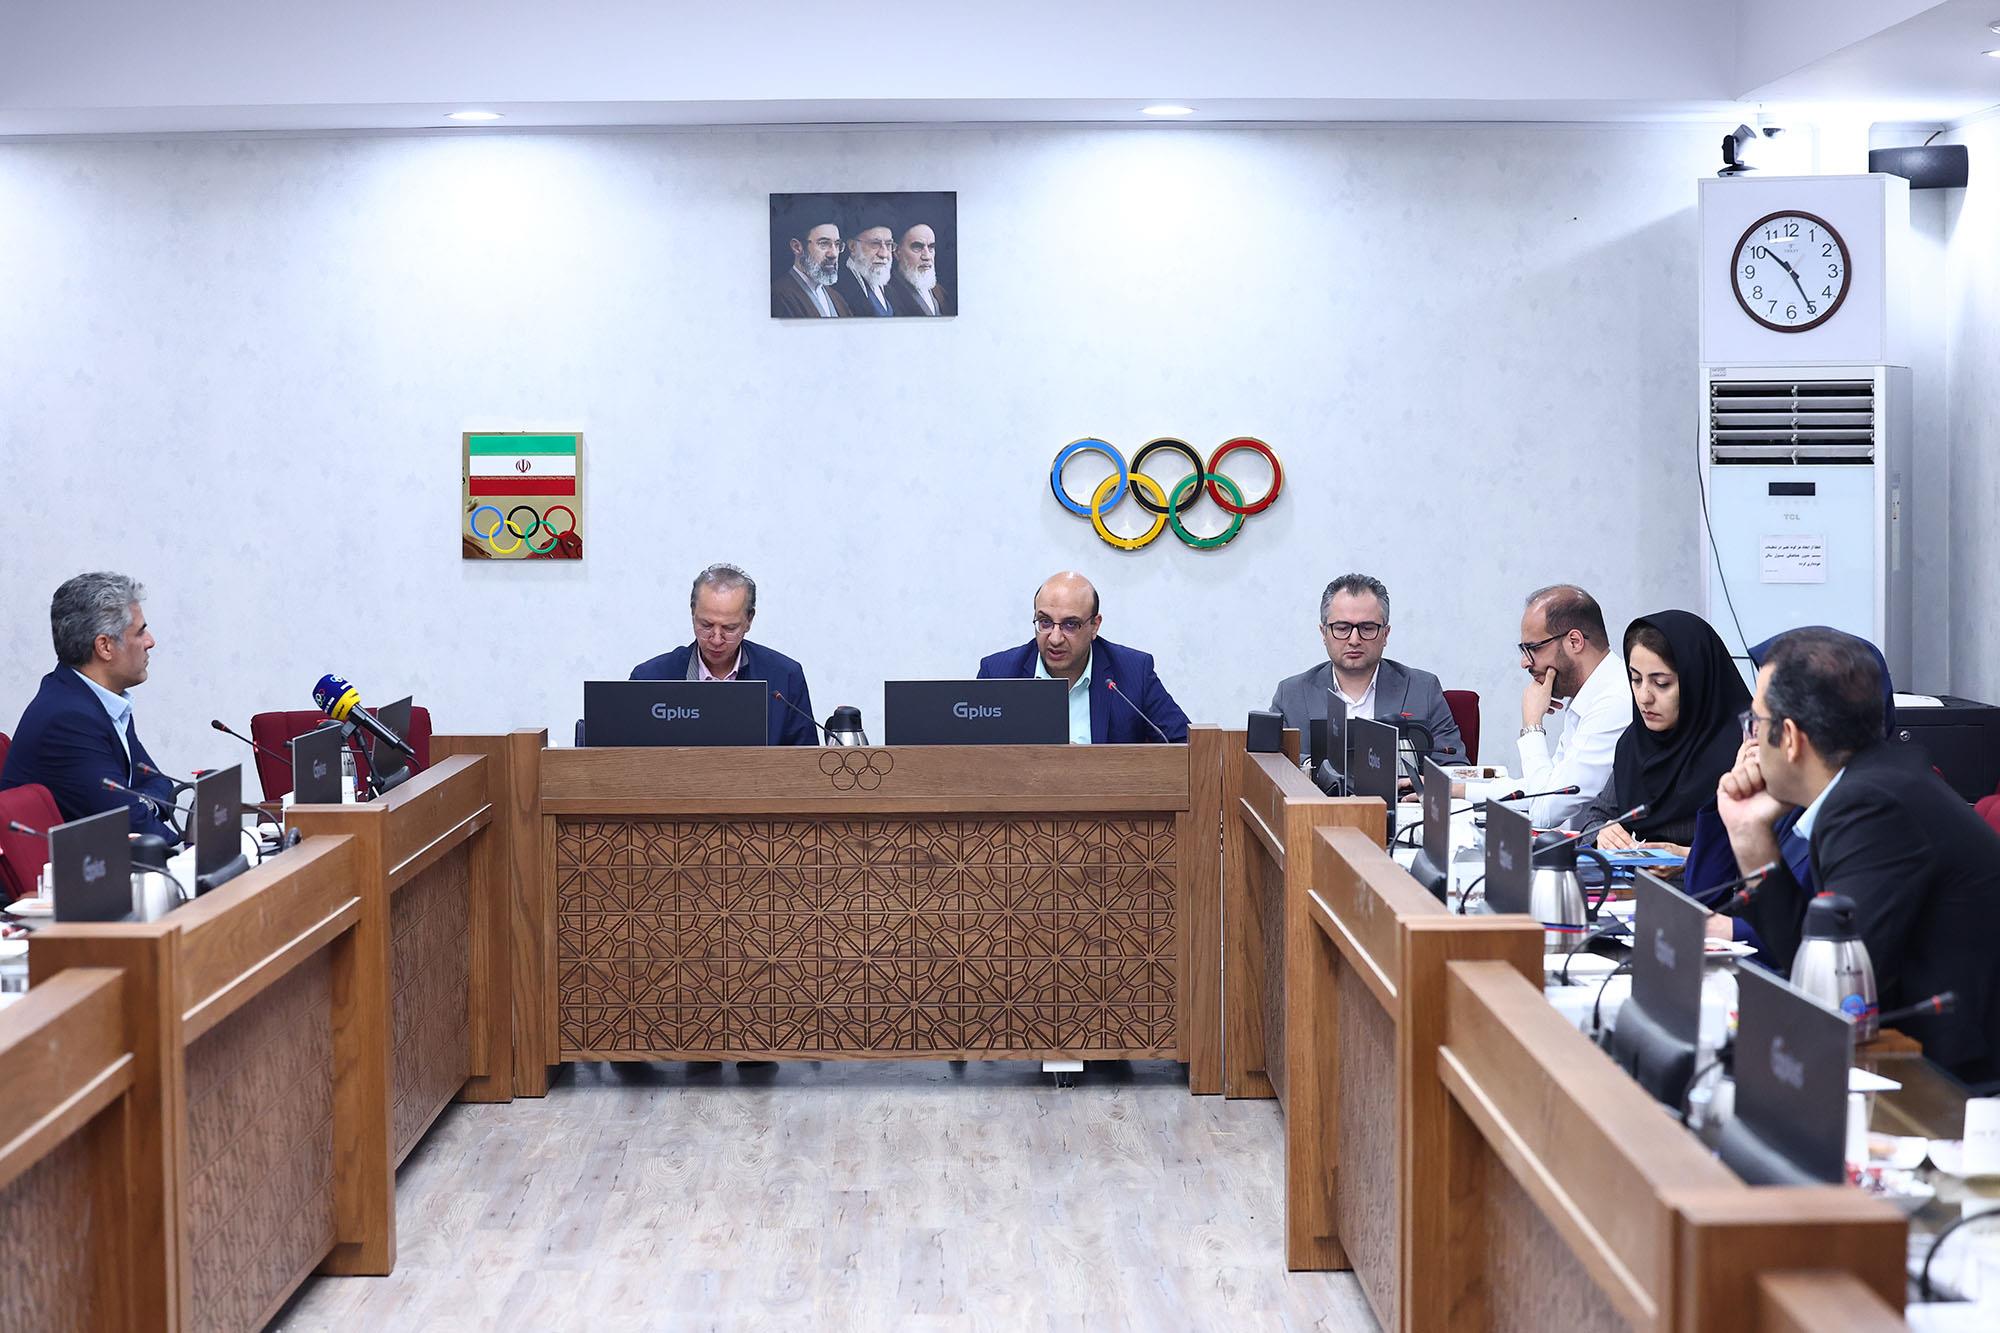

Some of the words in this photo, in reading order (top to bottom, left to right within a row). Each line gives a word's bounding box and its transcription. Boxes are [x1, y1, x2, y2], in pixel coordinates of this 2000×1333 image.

[1765, 230, 1778, 240] 11
[1783, 223, 1799, 237] 12
[1808, 229, 1815, 242] 1
[1750, 245, 1766, 259] 10
[1822, 243, 1832, 257] 2
[1744, 265, 1755, 279] 9
[1828, 264, 1838, 278] 3
[1752, 286, 1763, 299] 8
[1821, 285, 1832, 298] 4
[1768, 300, 1777, 313] 7
[1786, 305, 1797, 319] 6
[1806, 301, 1817, 314] 5
[652, 702, 700, 721] Gplus
[952, 701, 1001, 720] Gplus
